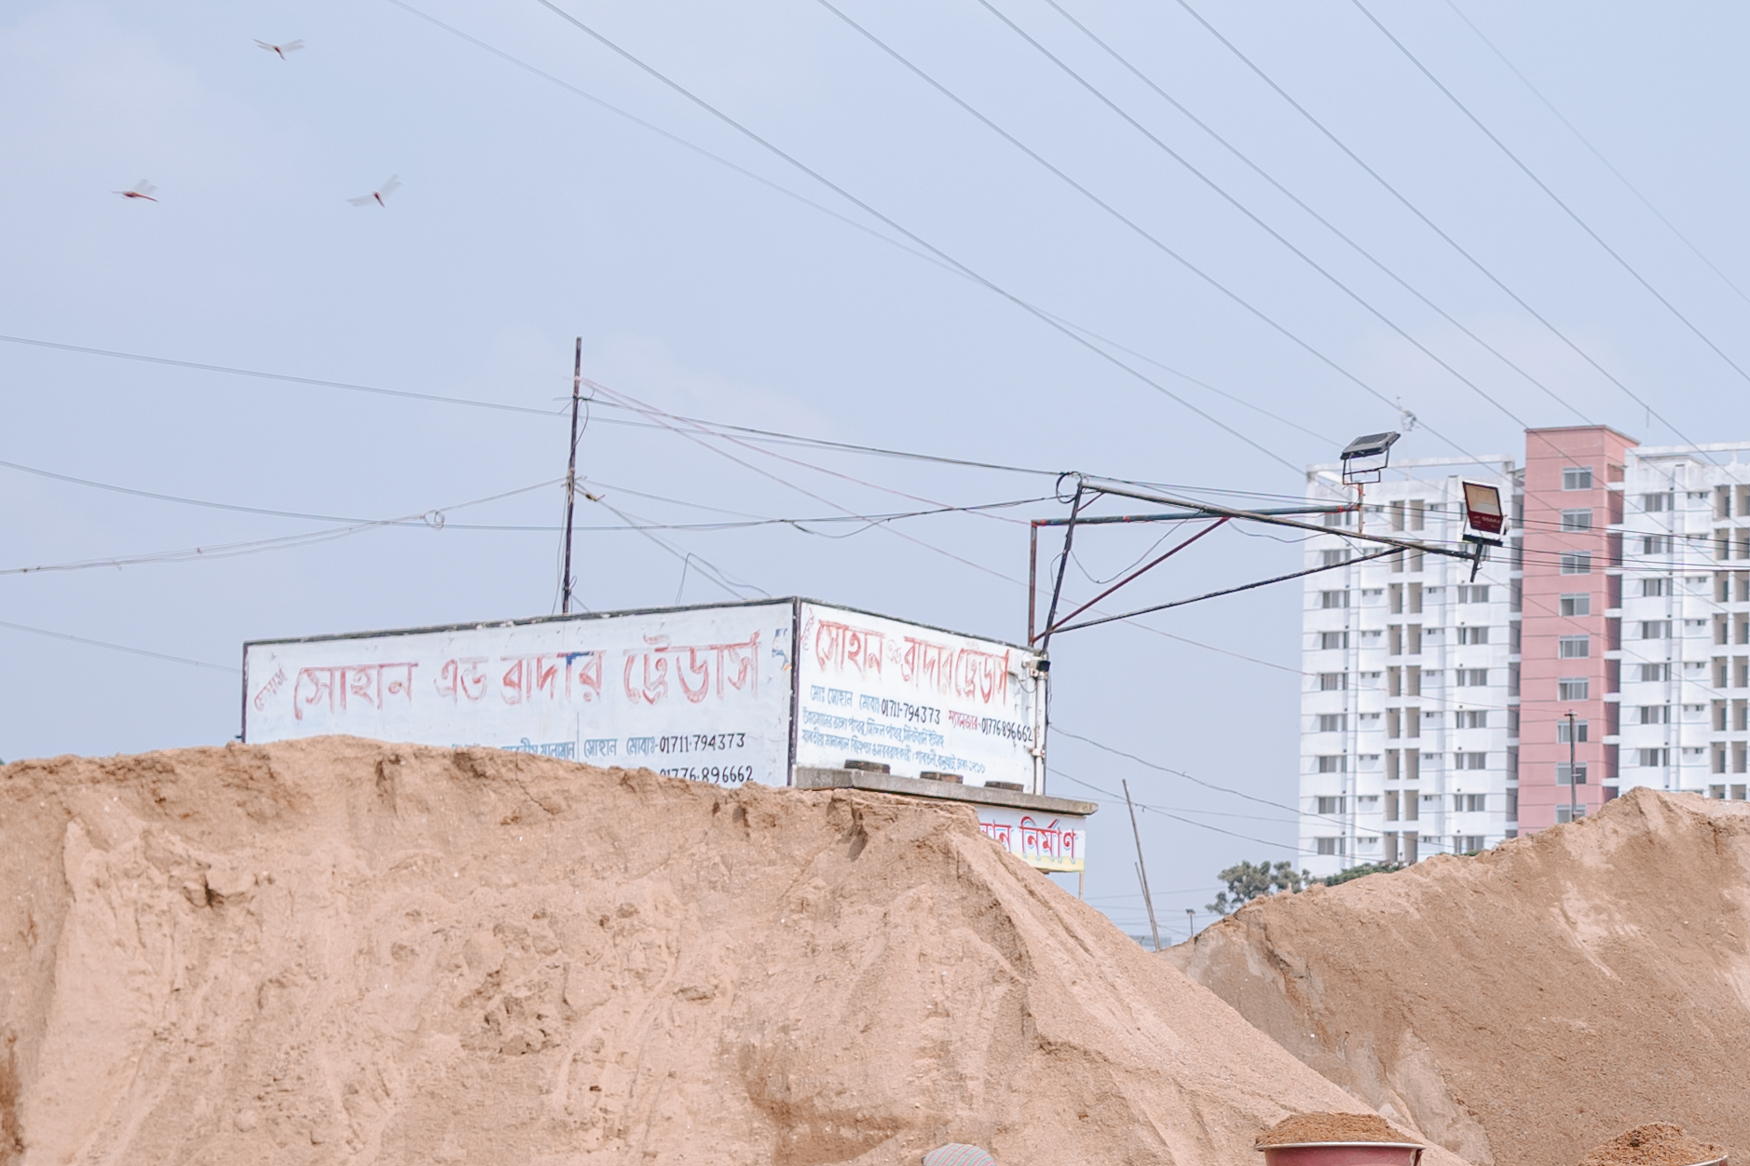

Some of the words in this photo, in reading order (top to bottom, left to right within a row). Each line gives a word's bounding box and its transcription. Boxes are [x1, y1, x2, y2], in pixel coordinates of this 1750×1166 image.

[815, 619, 885, 681] সোহান
[294, 662, 418, 720] সোহান
[827, 687, 853, 708] সোহান
[584, 738, 617, 758] সোহান
[1019, 815, 1077, 862] নির্মাণ
